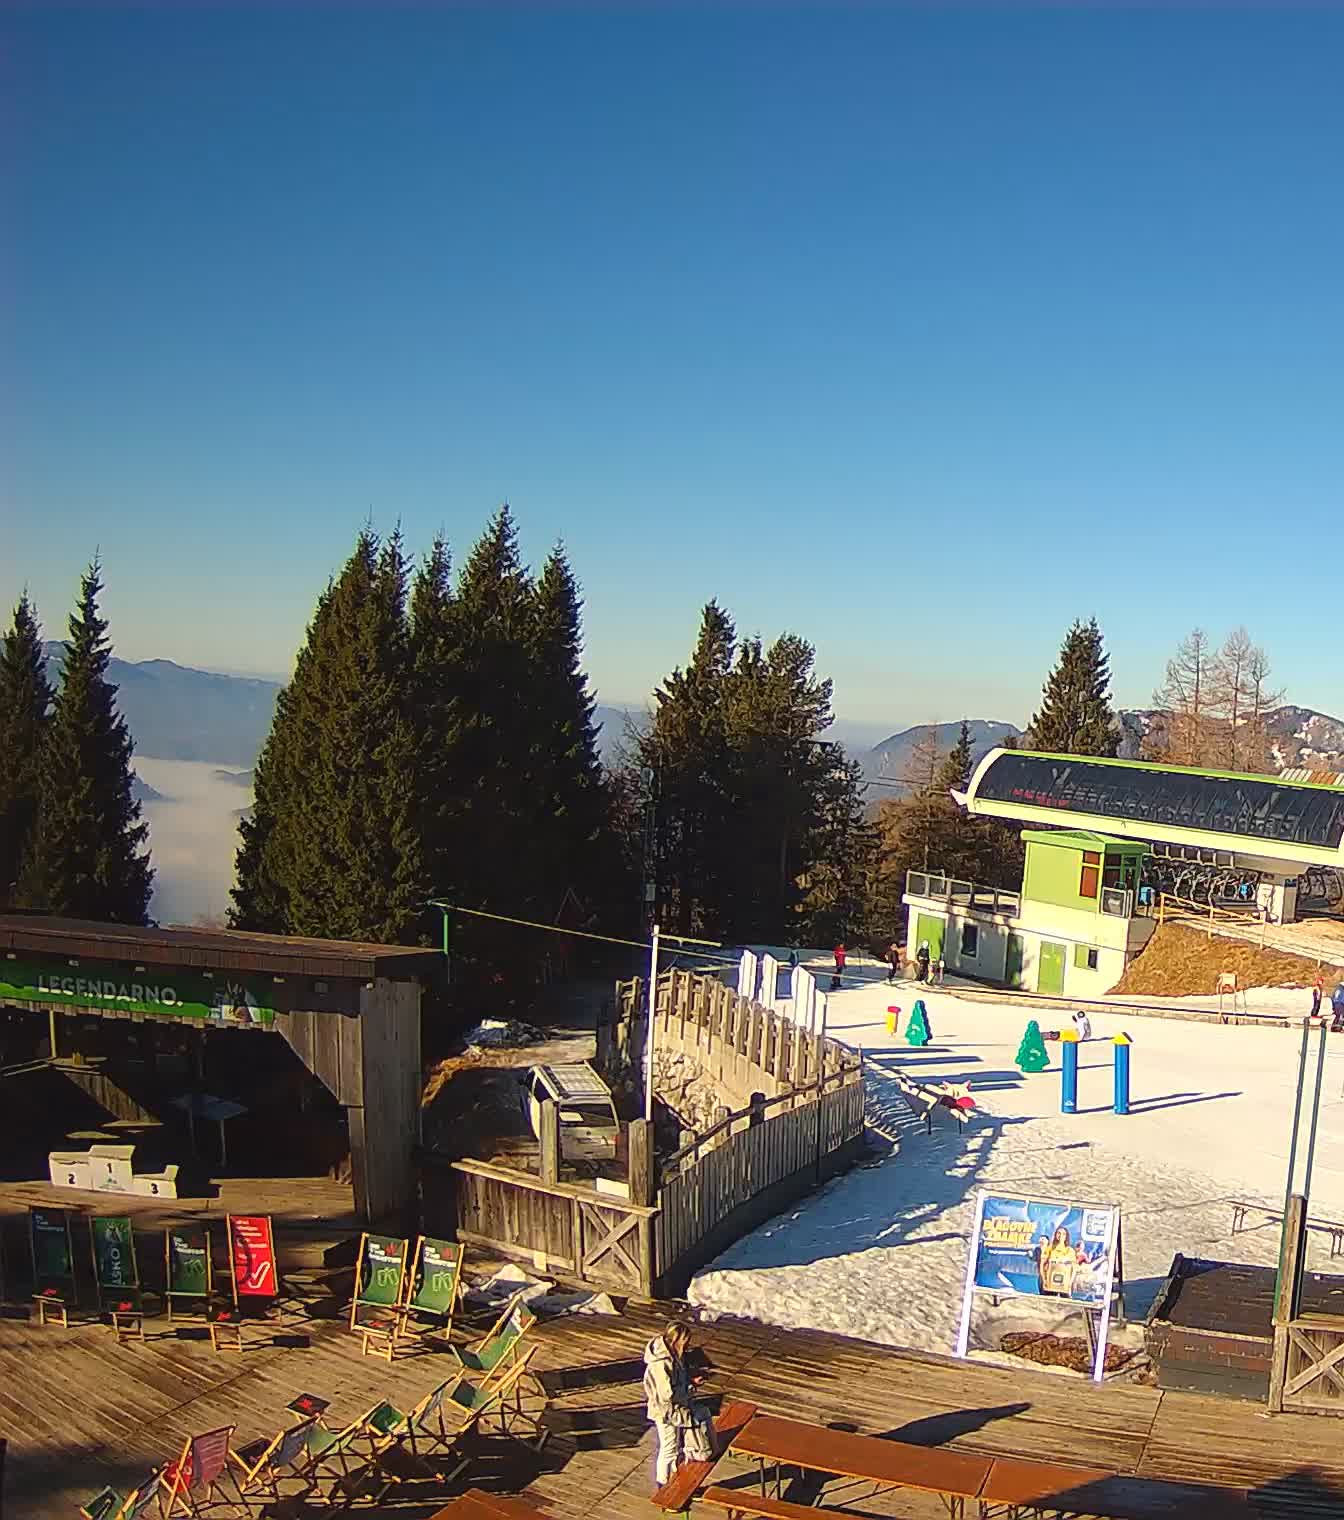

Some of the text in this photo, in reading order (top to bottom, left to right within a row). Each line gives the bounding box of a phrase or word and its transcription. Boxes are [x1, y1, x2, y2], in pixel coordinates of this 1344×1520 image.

[106, 1162, 113, 1174] 1
[68, 1173, 76, 1185] 2
[150, 1183, 159, 1195] 3
